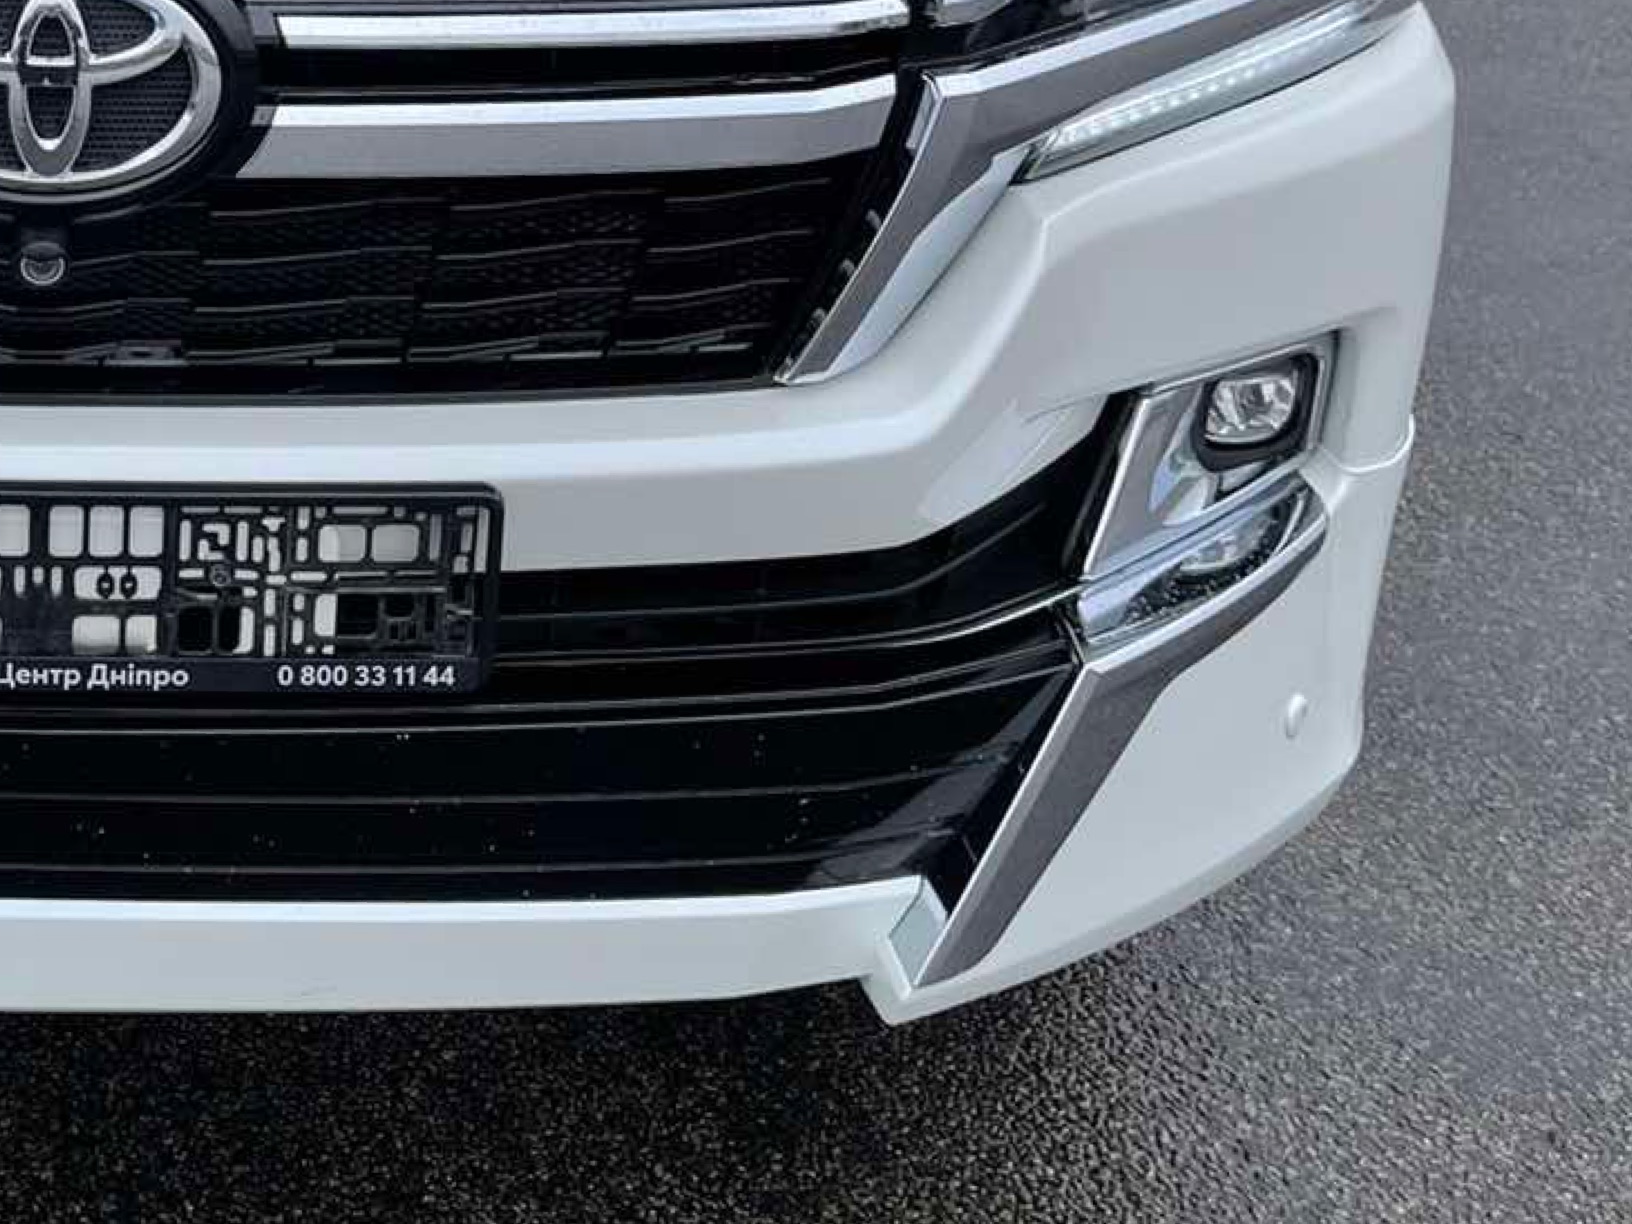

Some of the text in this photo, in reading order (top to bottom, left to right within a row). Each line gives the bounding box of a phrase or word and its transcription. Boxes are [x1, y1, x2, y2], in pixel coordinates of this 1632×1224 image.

[86, 663, 189, 691] Дніпро
[277, 664, 455, 686] 0 800 33 11 44
